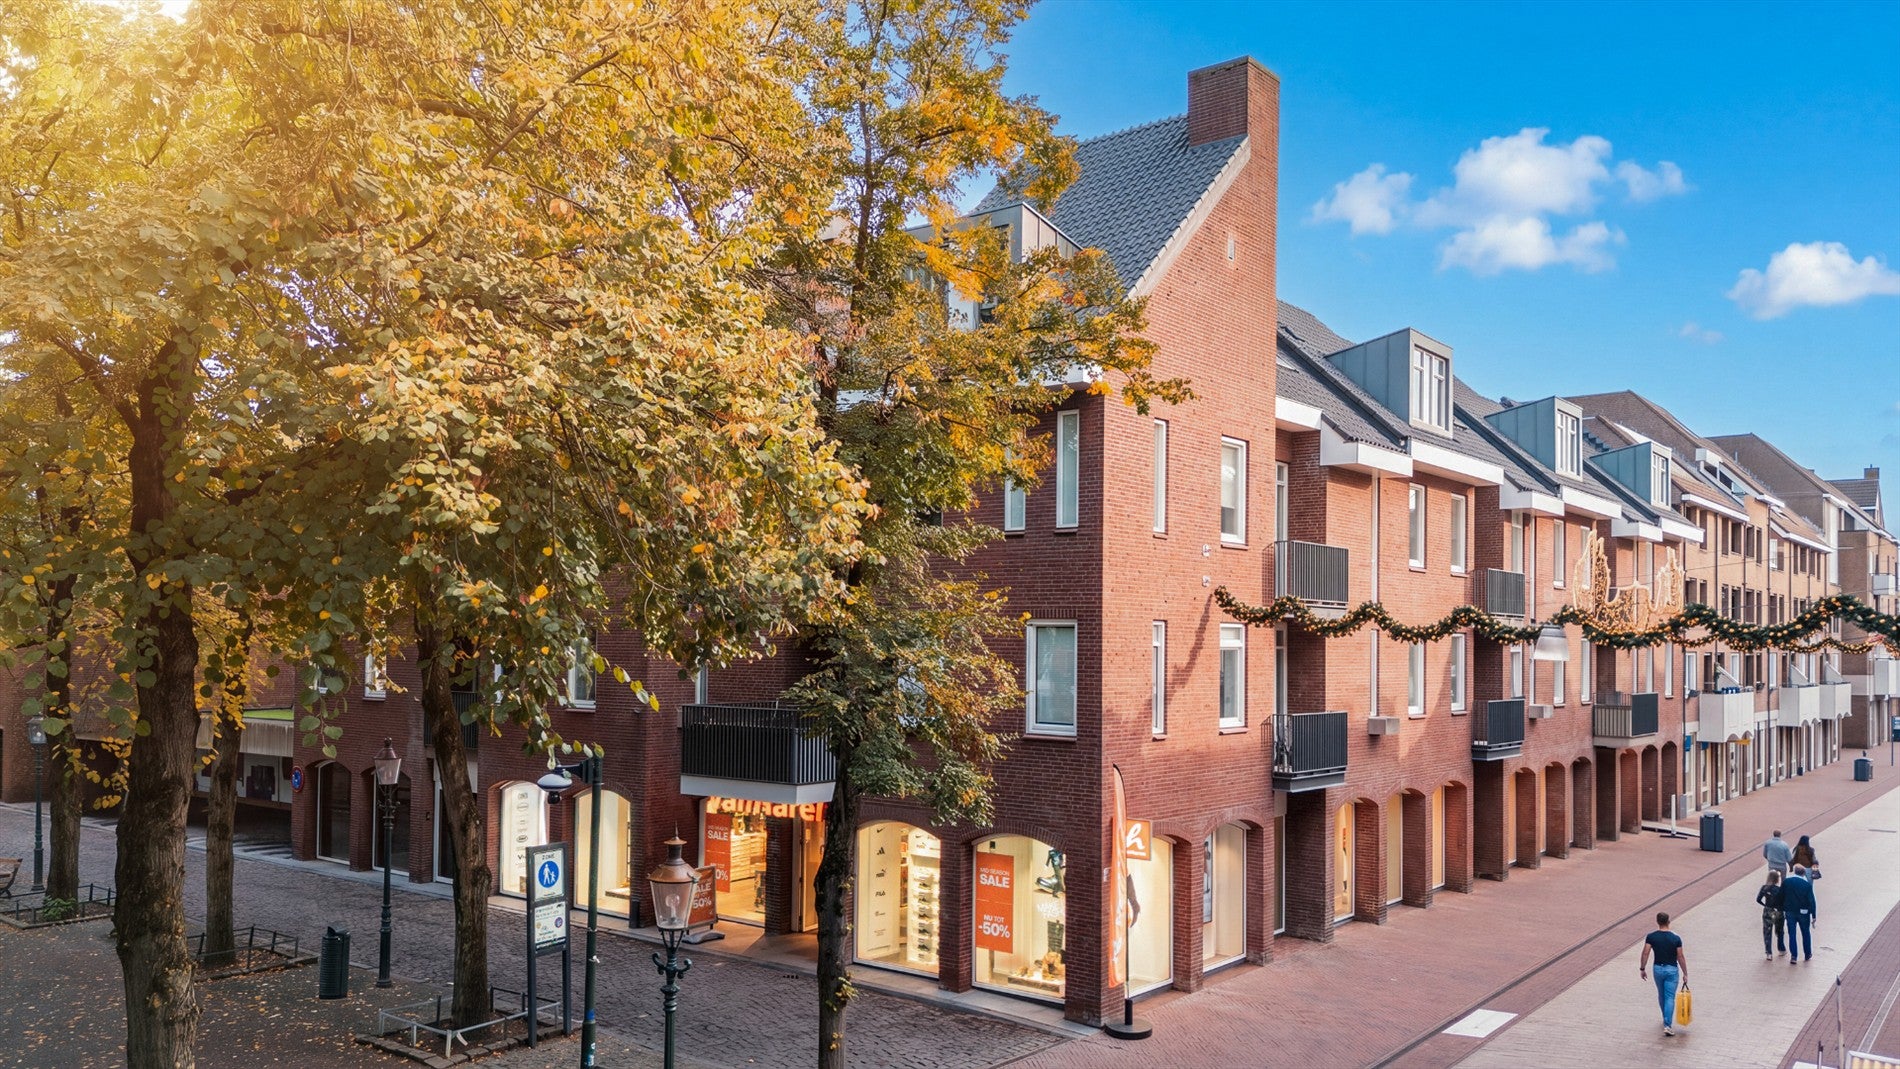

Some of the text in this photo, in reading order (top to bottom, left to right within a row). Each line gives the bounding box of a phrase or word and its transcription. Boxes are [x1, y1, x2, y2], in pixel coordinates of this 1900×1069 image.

[707, 830, 728, 841] SALE
[715, 869, 728, 881] 0%
[979, 874, 1010, 888] SALE
[695, 882, 712, 893] ALE
[692, 896, 712, 909] 50%
[983, 914, 993, 922] NU
[978, 921, 1010, 938] -50%
